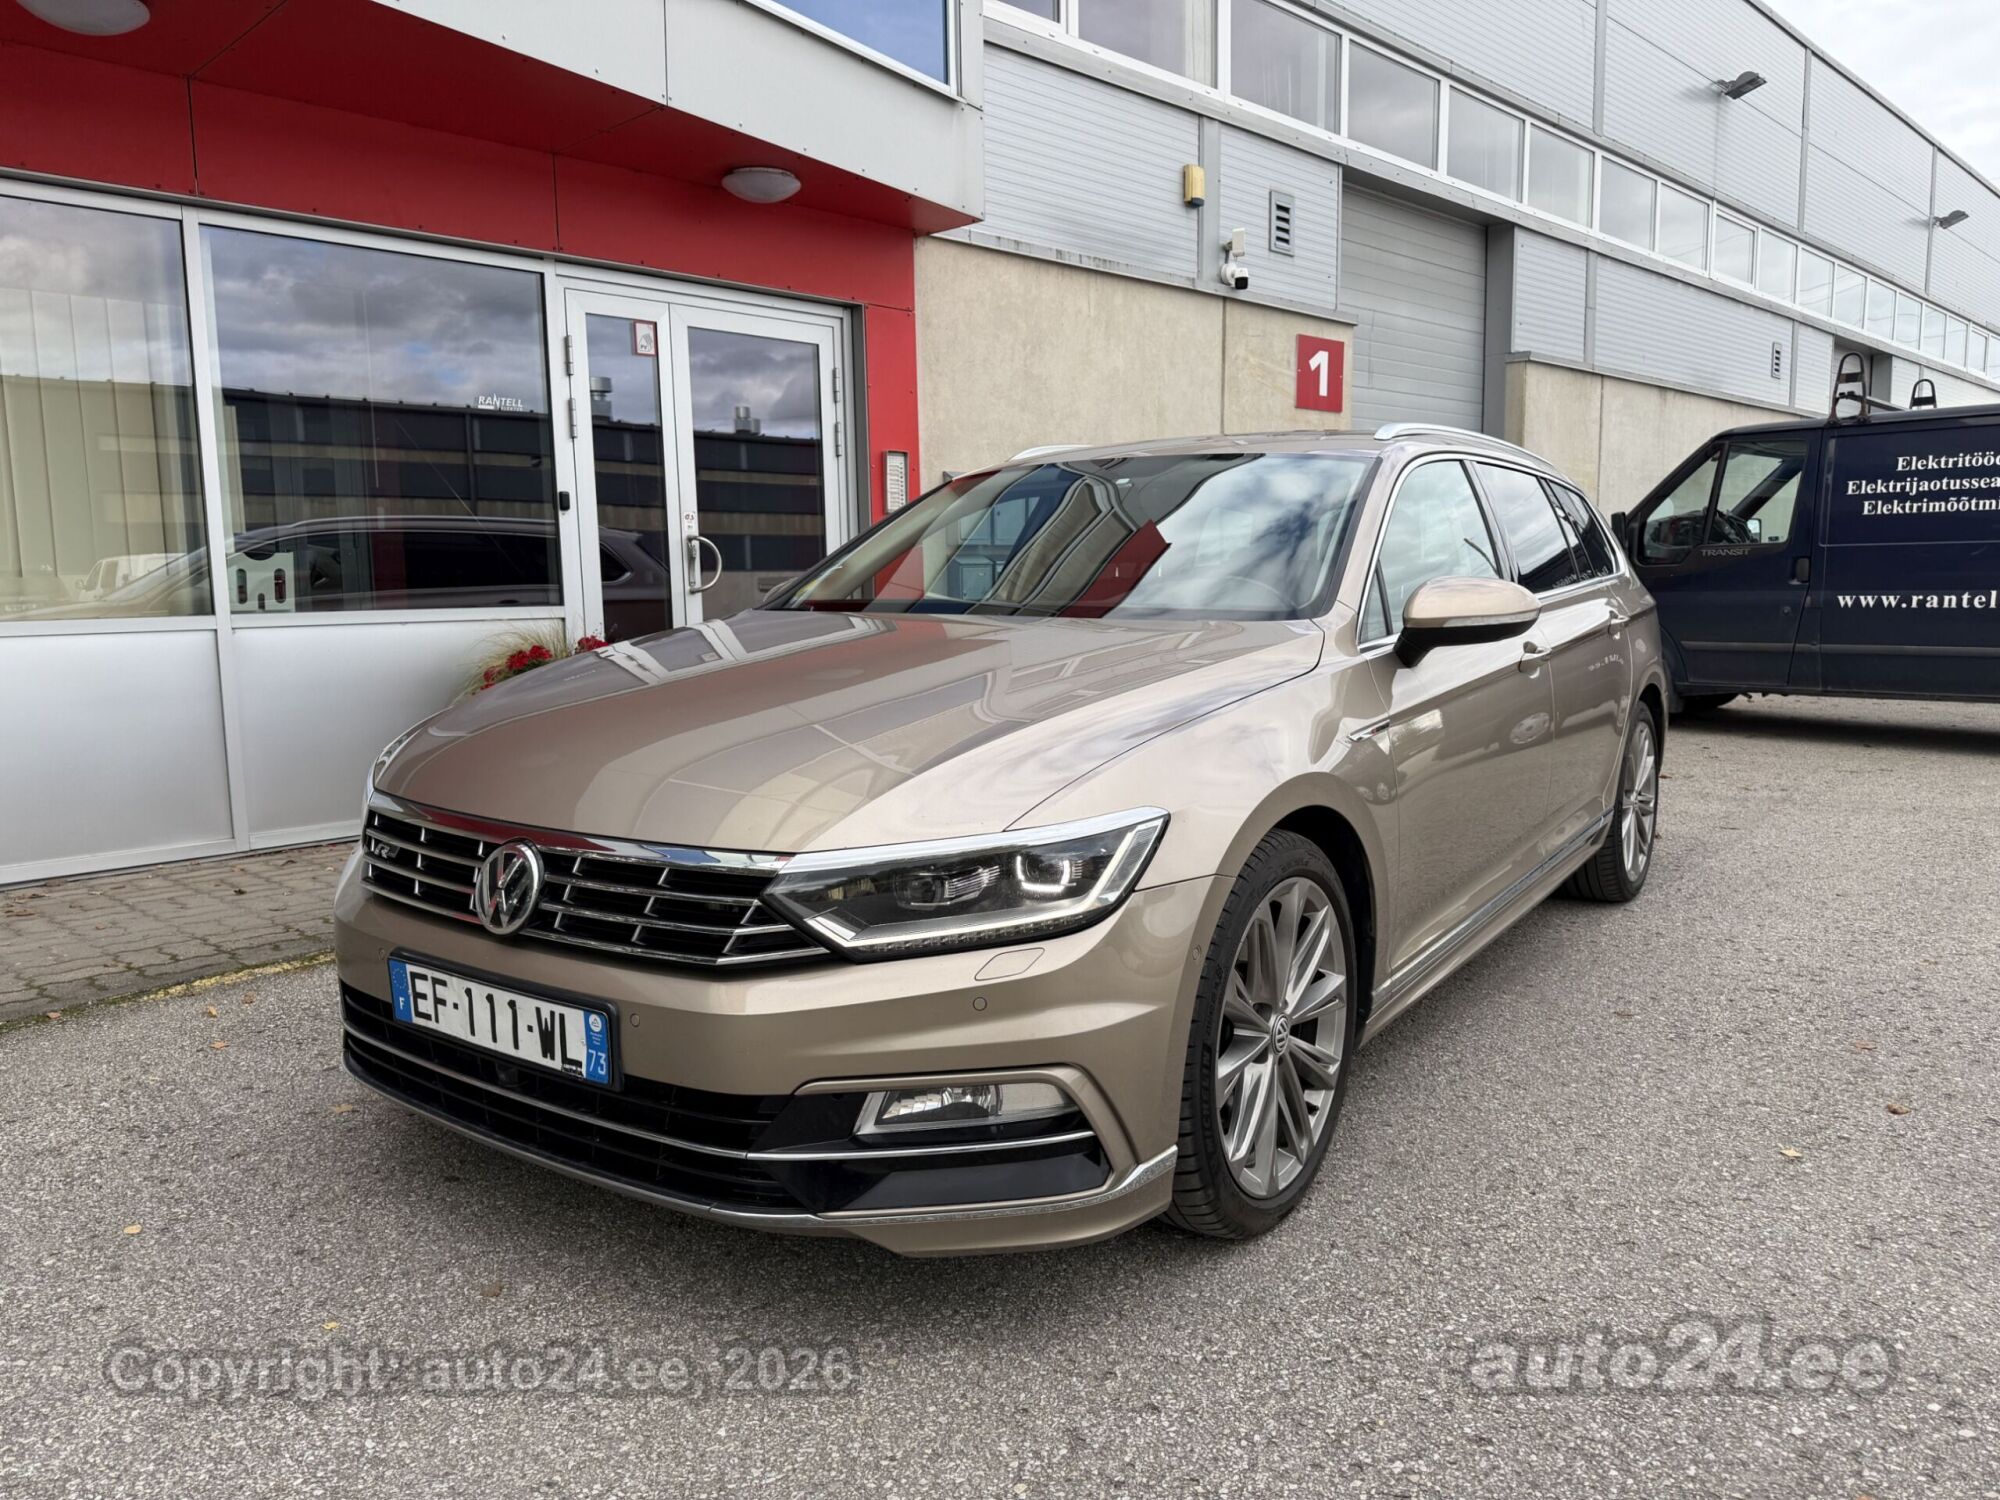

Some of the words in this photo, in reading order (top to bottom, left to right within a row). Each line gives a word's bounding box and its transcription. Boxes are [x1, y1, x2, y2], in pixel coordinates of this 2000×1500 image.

[1308, 350, 1329, 397] 1
[478, 393, 523, 408] RANTELL
[1846, 476, 2000, 496] Elektrijaotussea
[1862, 496, 2000, 515] Elektrimõõtm
[1700, 548, 1751, 557] TRANSIT
[1837, 590, 1997, 608] www.rantel
[399, 997, 405, 1011] F
[409, 971, 583, 1069] EF-111-WL
[588, 1048, 606, 1076] 73
